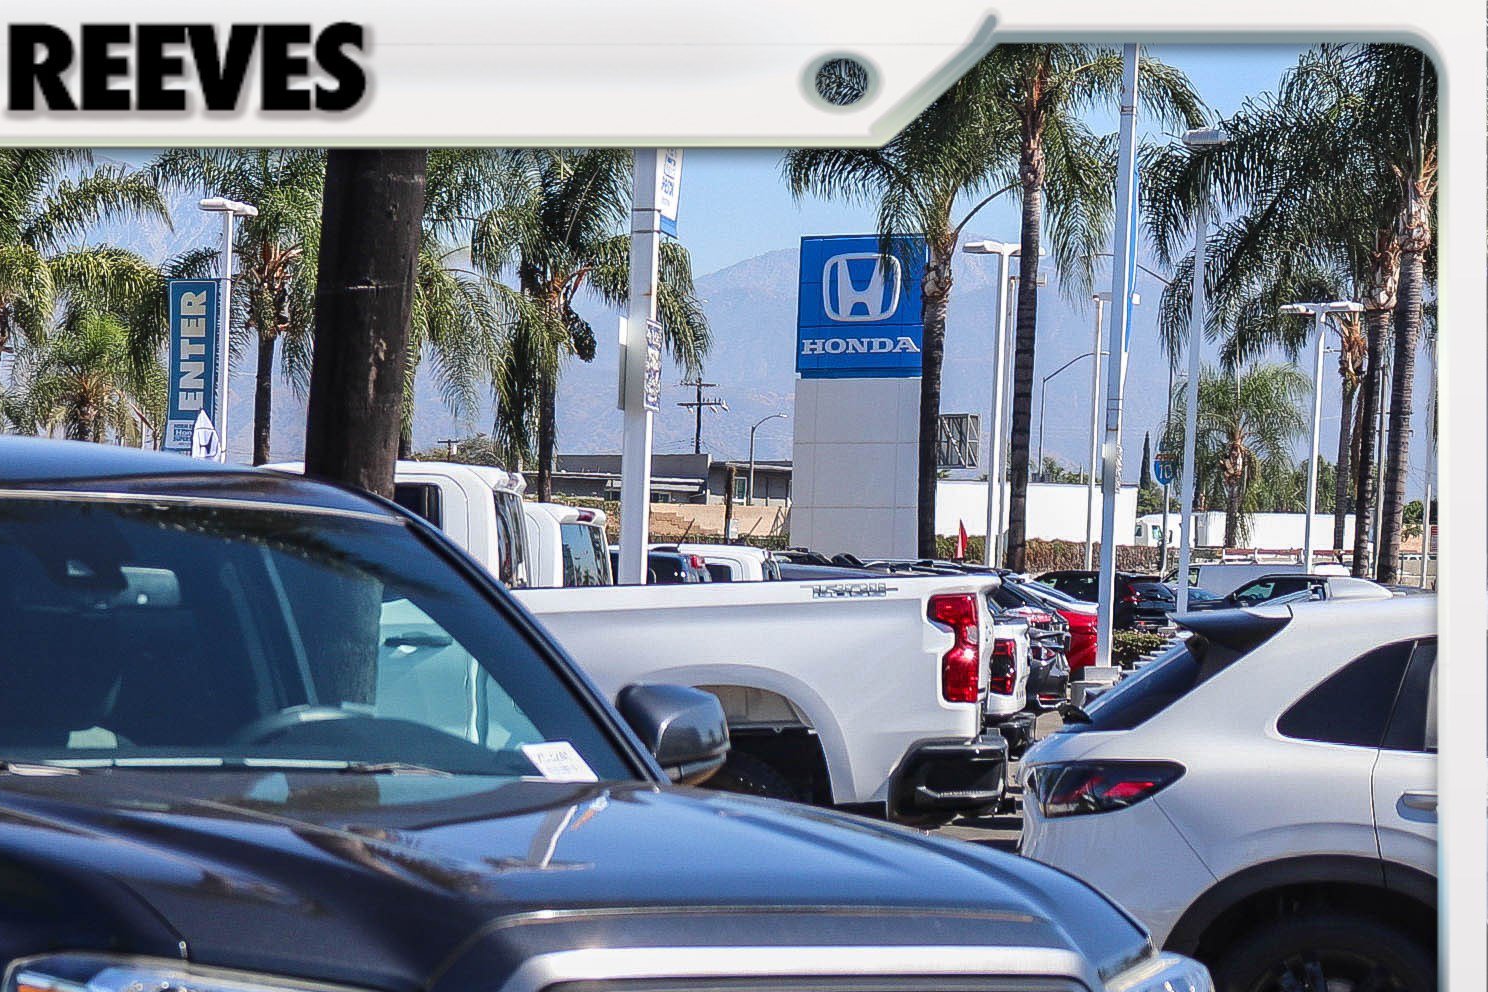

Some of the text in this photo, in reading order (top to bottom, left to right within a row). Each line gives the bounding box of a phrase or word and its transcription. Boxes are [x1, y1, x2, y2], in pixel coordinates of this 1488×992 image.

[178, 290, 207, 411] ENTER
[801, 336, 921, 355] HONDA
[1158, 464, 1172, 479] 10
